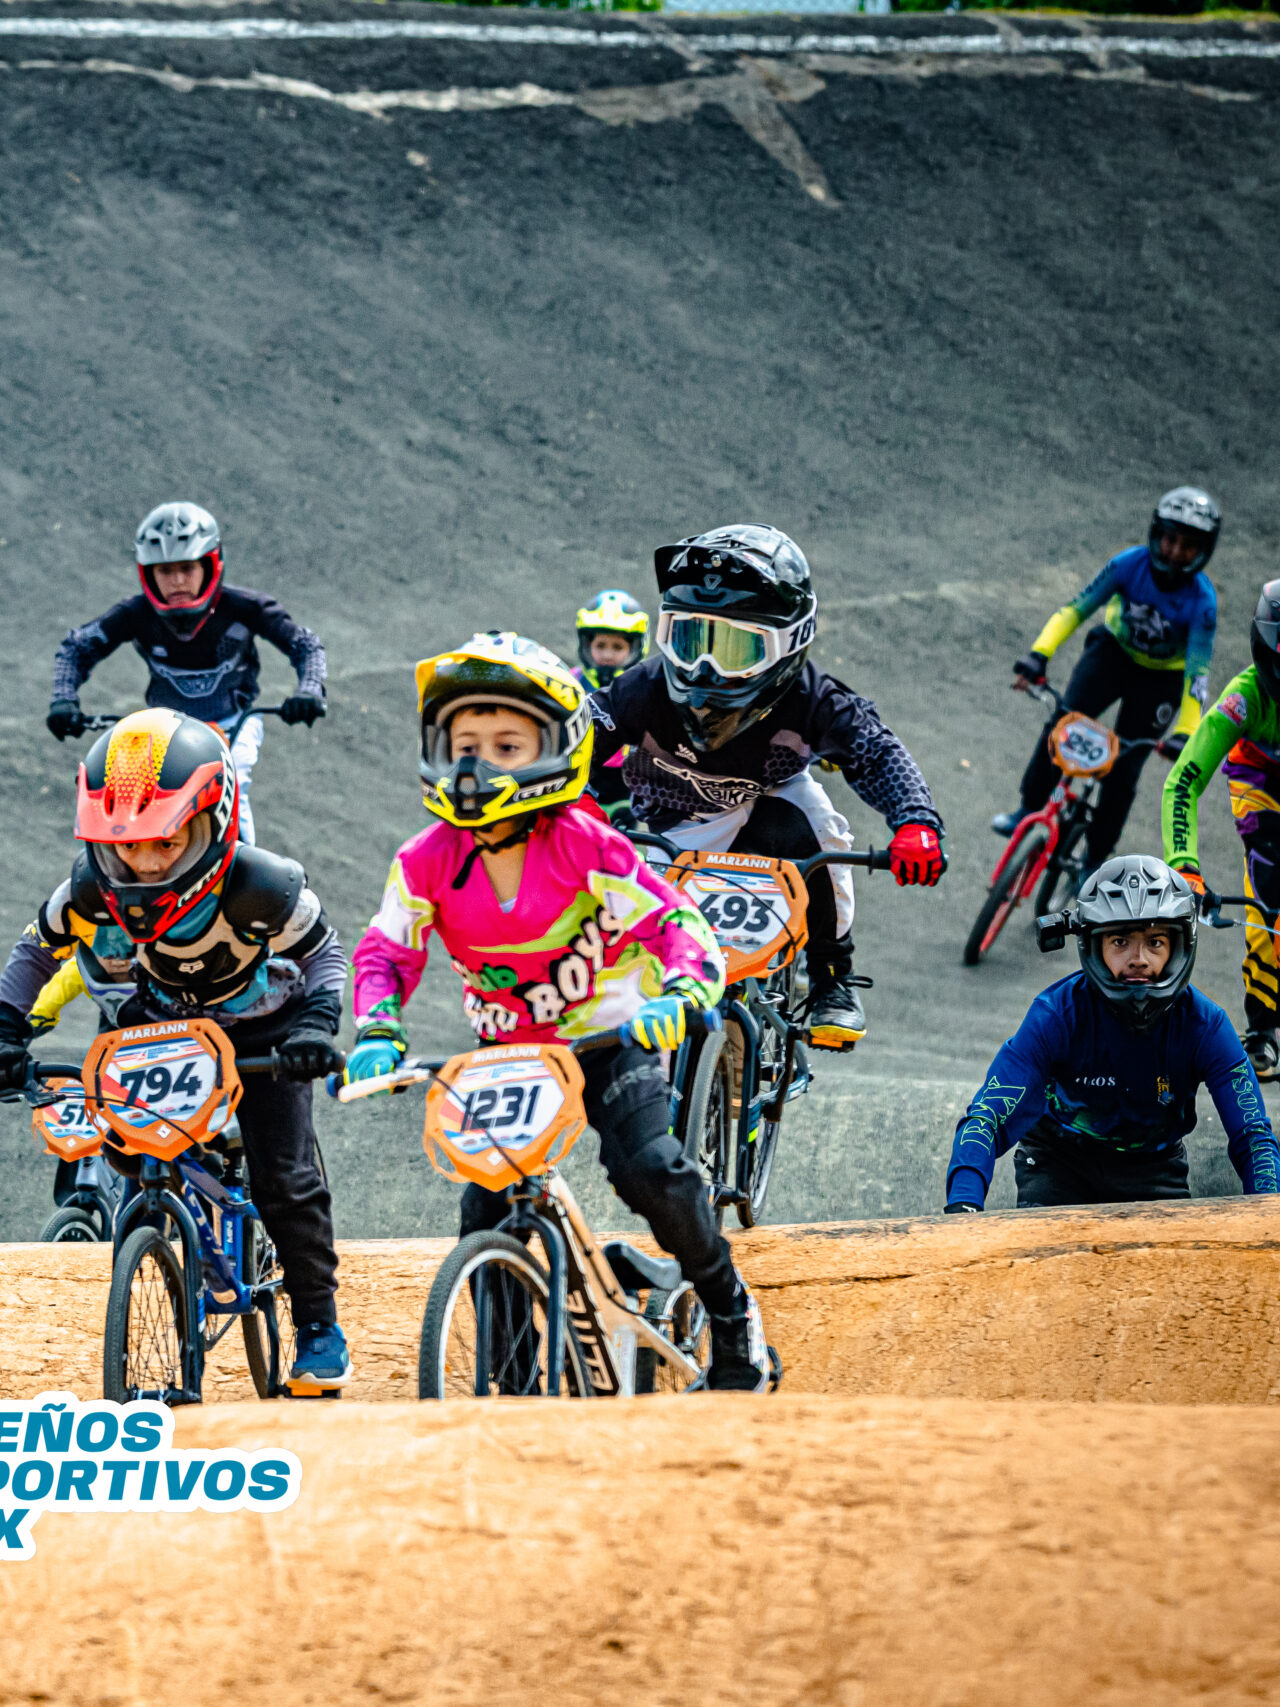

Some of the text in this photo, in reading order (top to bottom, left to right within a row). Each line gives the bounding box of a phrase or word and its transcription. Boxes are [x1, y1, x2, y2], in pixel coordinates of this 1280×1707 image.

[787, 615, 817, 653] 10
[698, 893, 775, 933] 493
[514, 905, 624, 1024] BOYS
[120, 1061, 202, 1108] 794
[460, 1084, 543, 1133] 1231
